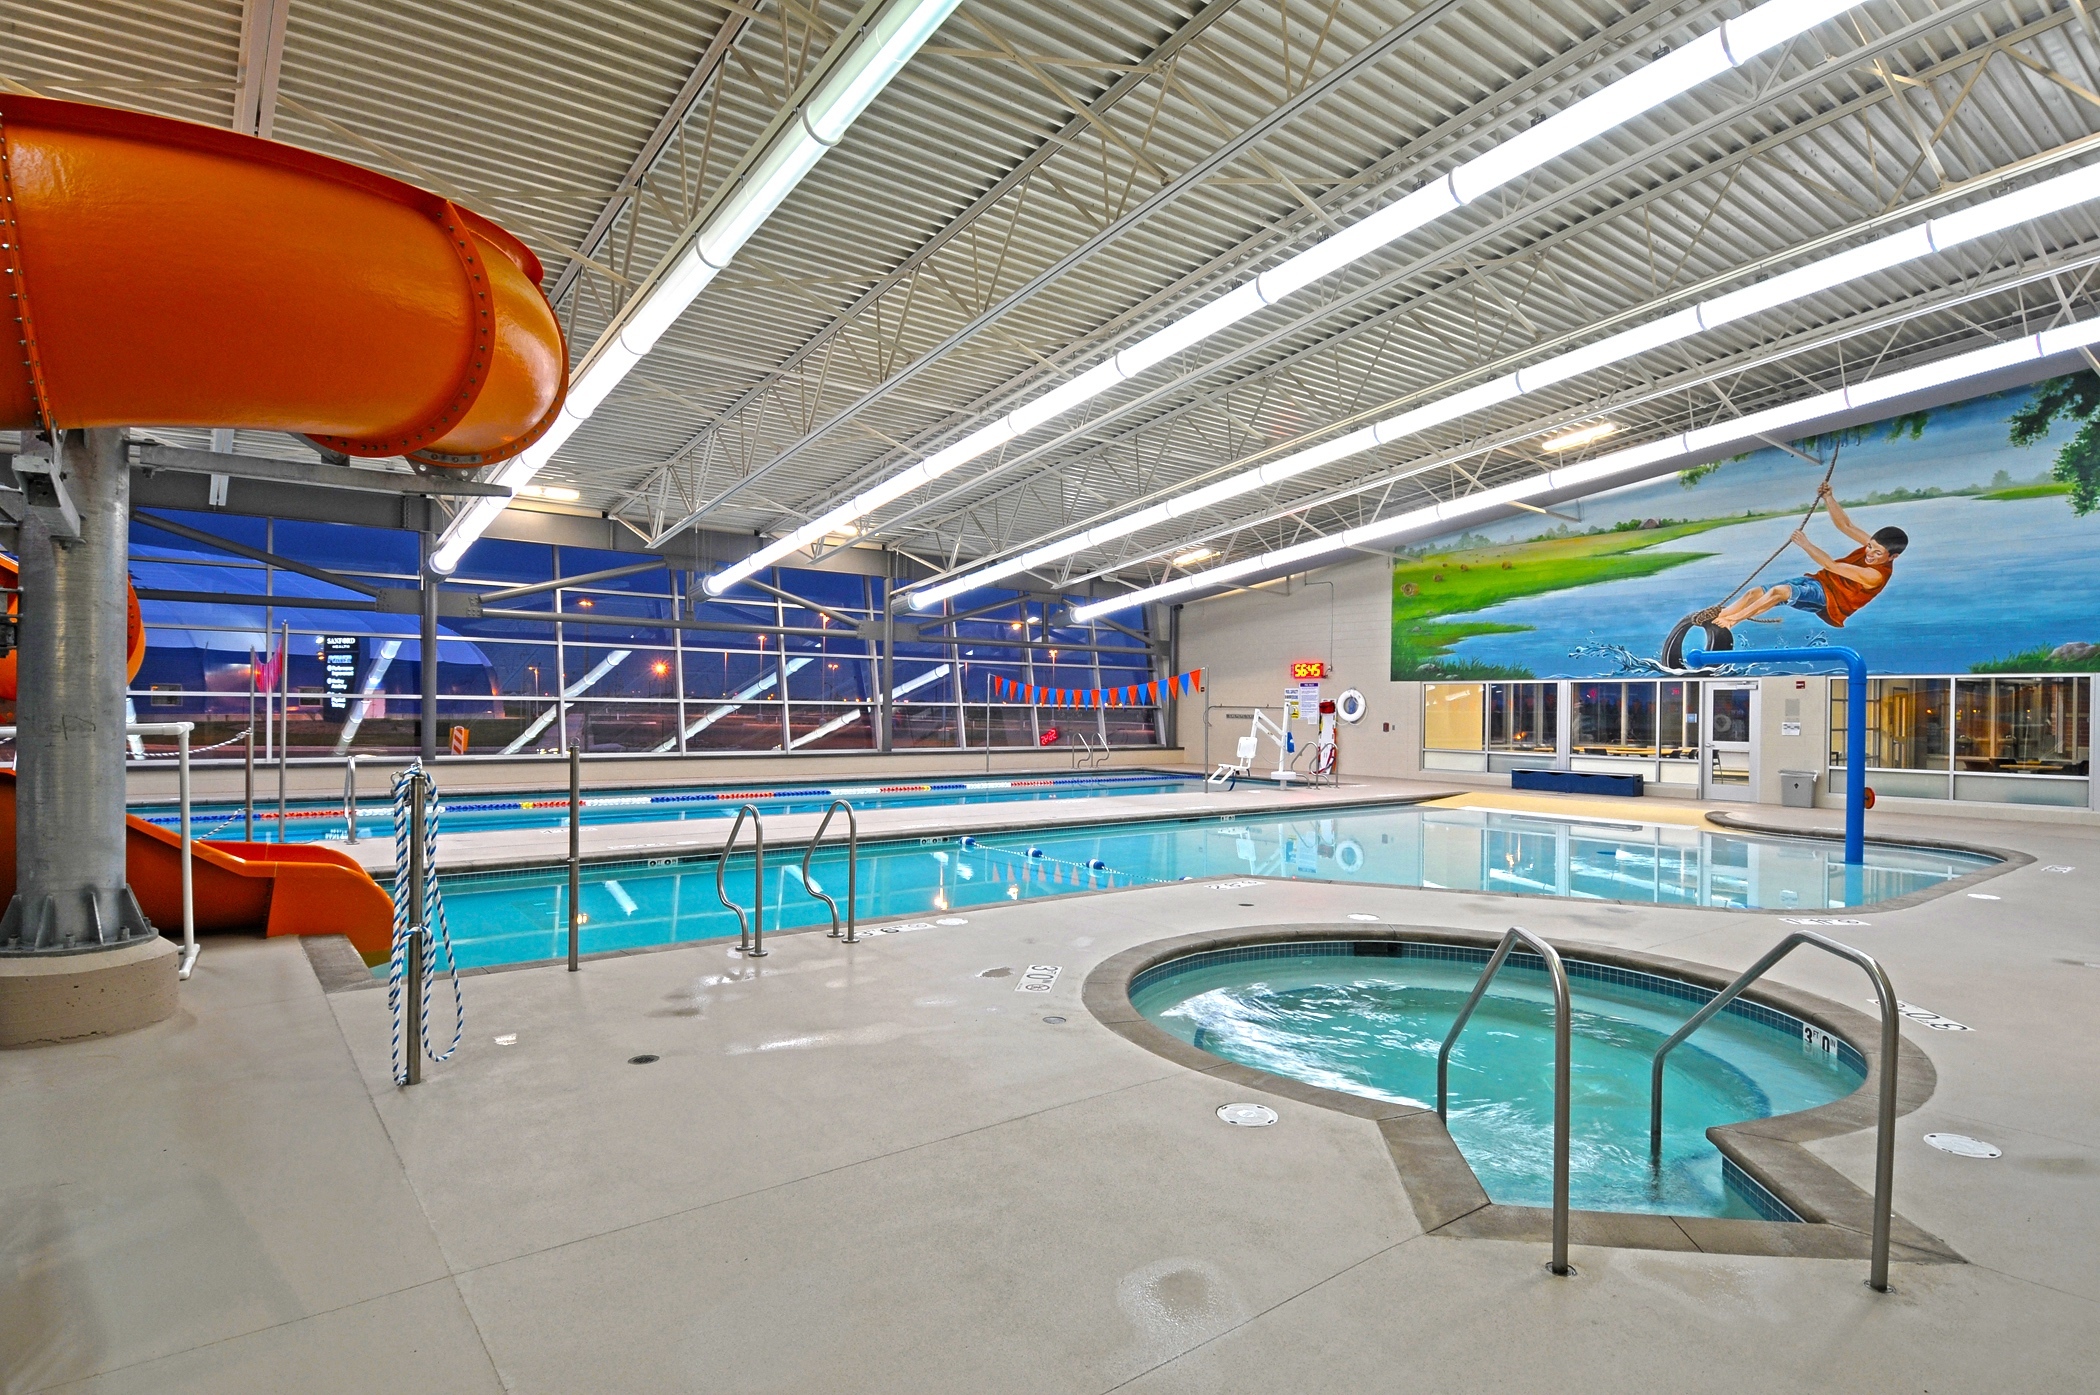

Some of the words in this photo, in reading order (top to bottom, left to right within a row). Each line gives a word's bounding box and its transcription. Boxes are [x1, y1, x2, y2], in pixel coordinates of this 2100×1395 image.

[1294, 663, 1321, 677] 56:45
[1805, 1027, 1812, 1044] 3
[1813, 1031, 1819, 1039] FT
